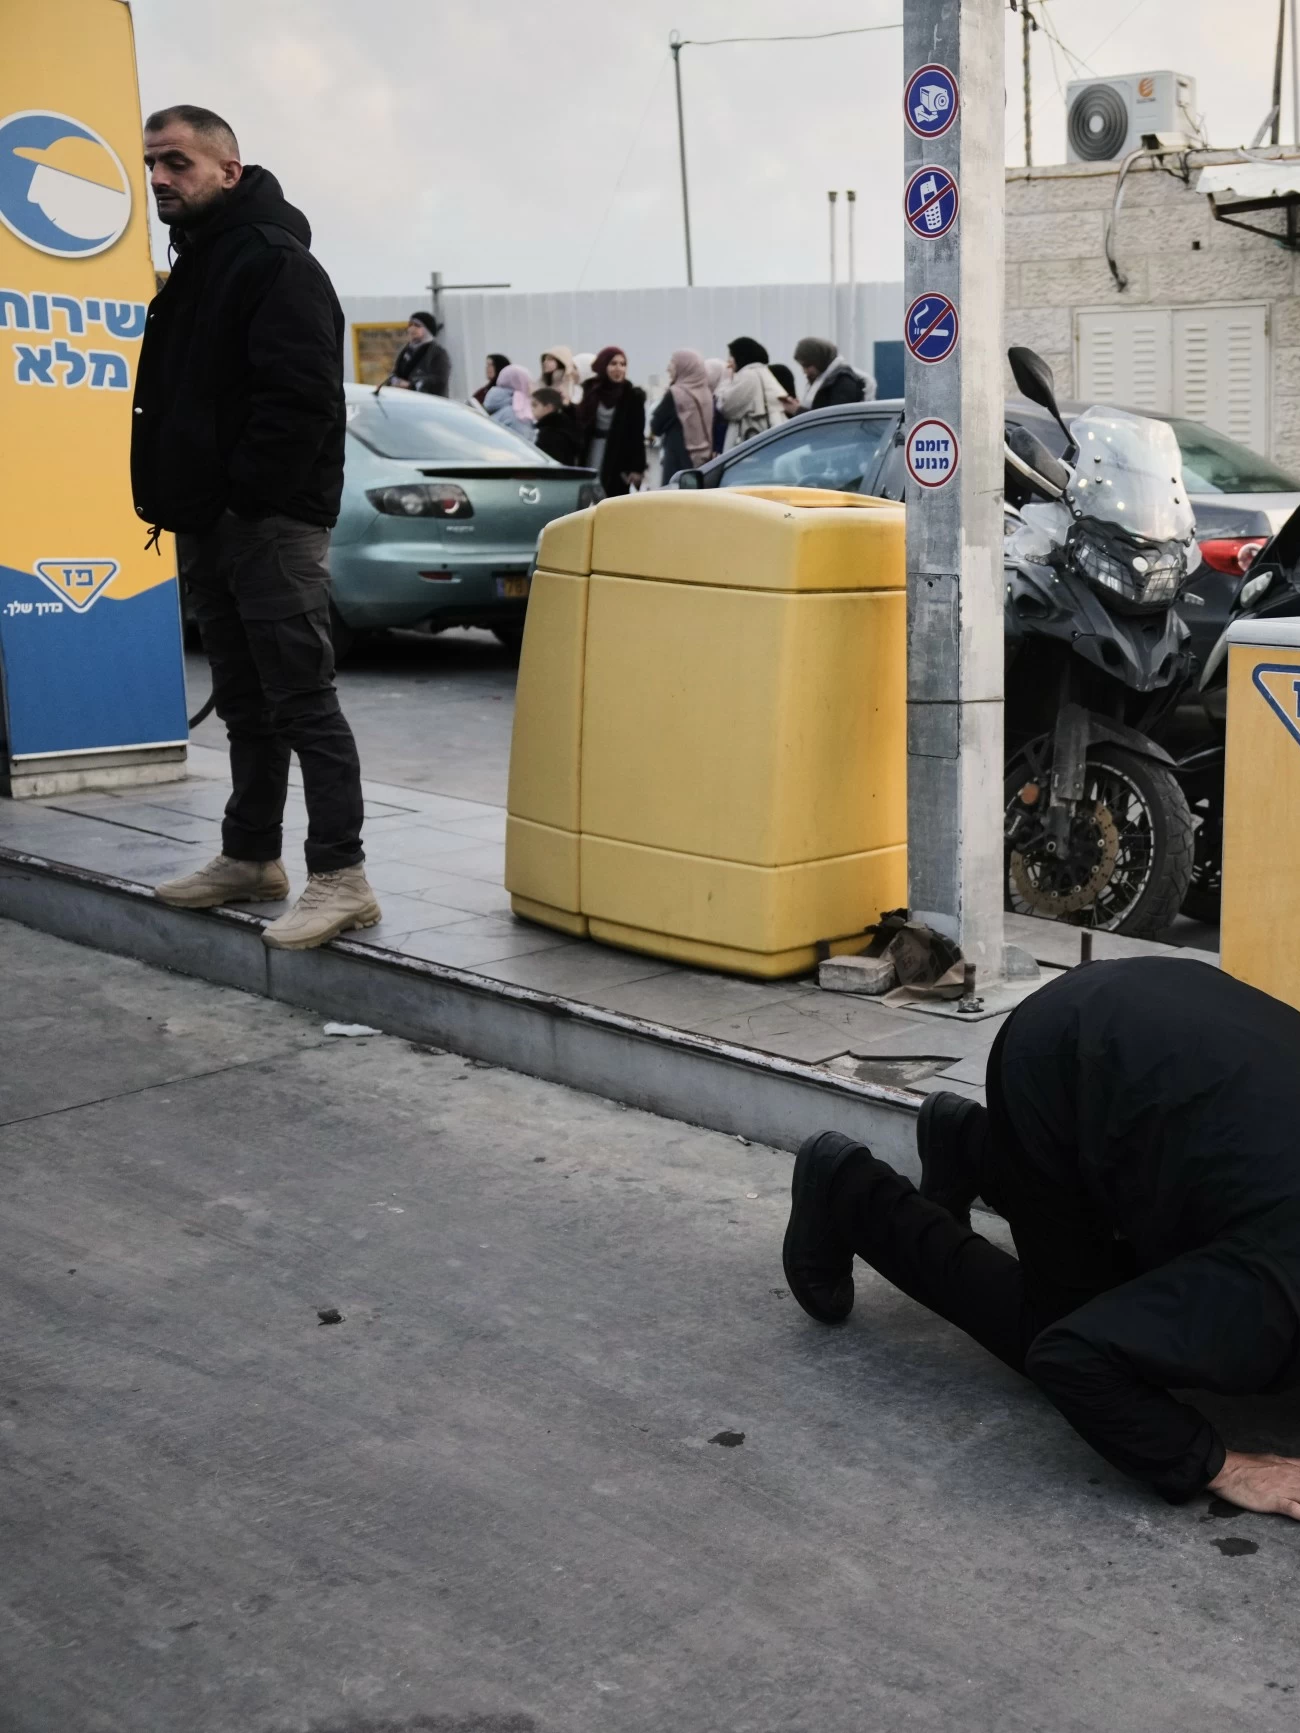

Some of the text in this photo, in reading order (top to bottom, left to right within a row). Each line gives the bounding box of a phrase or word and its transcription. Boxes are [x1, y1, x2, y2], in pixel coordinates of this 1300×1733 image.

[0, 288, 147, 340] שירות
[14, 340, 130, 389] מלא
[915, 440, 950, 452] דומם
[915, 457, 950, 470] מנוע
[62, 568, 95, 588] פז
